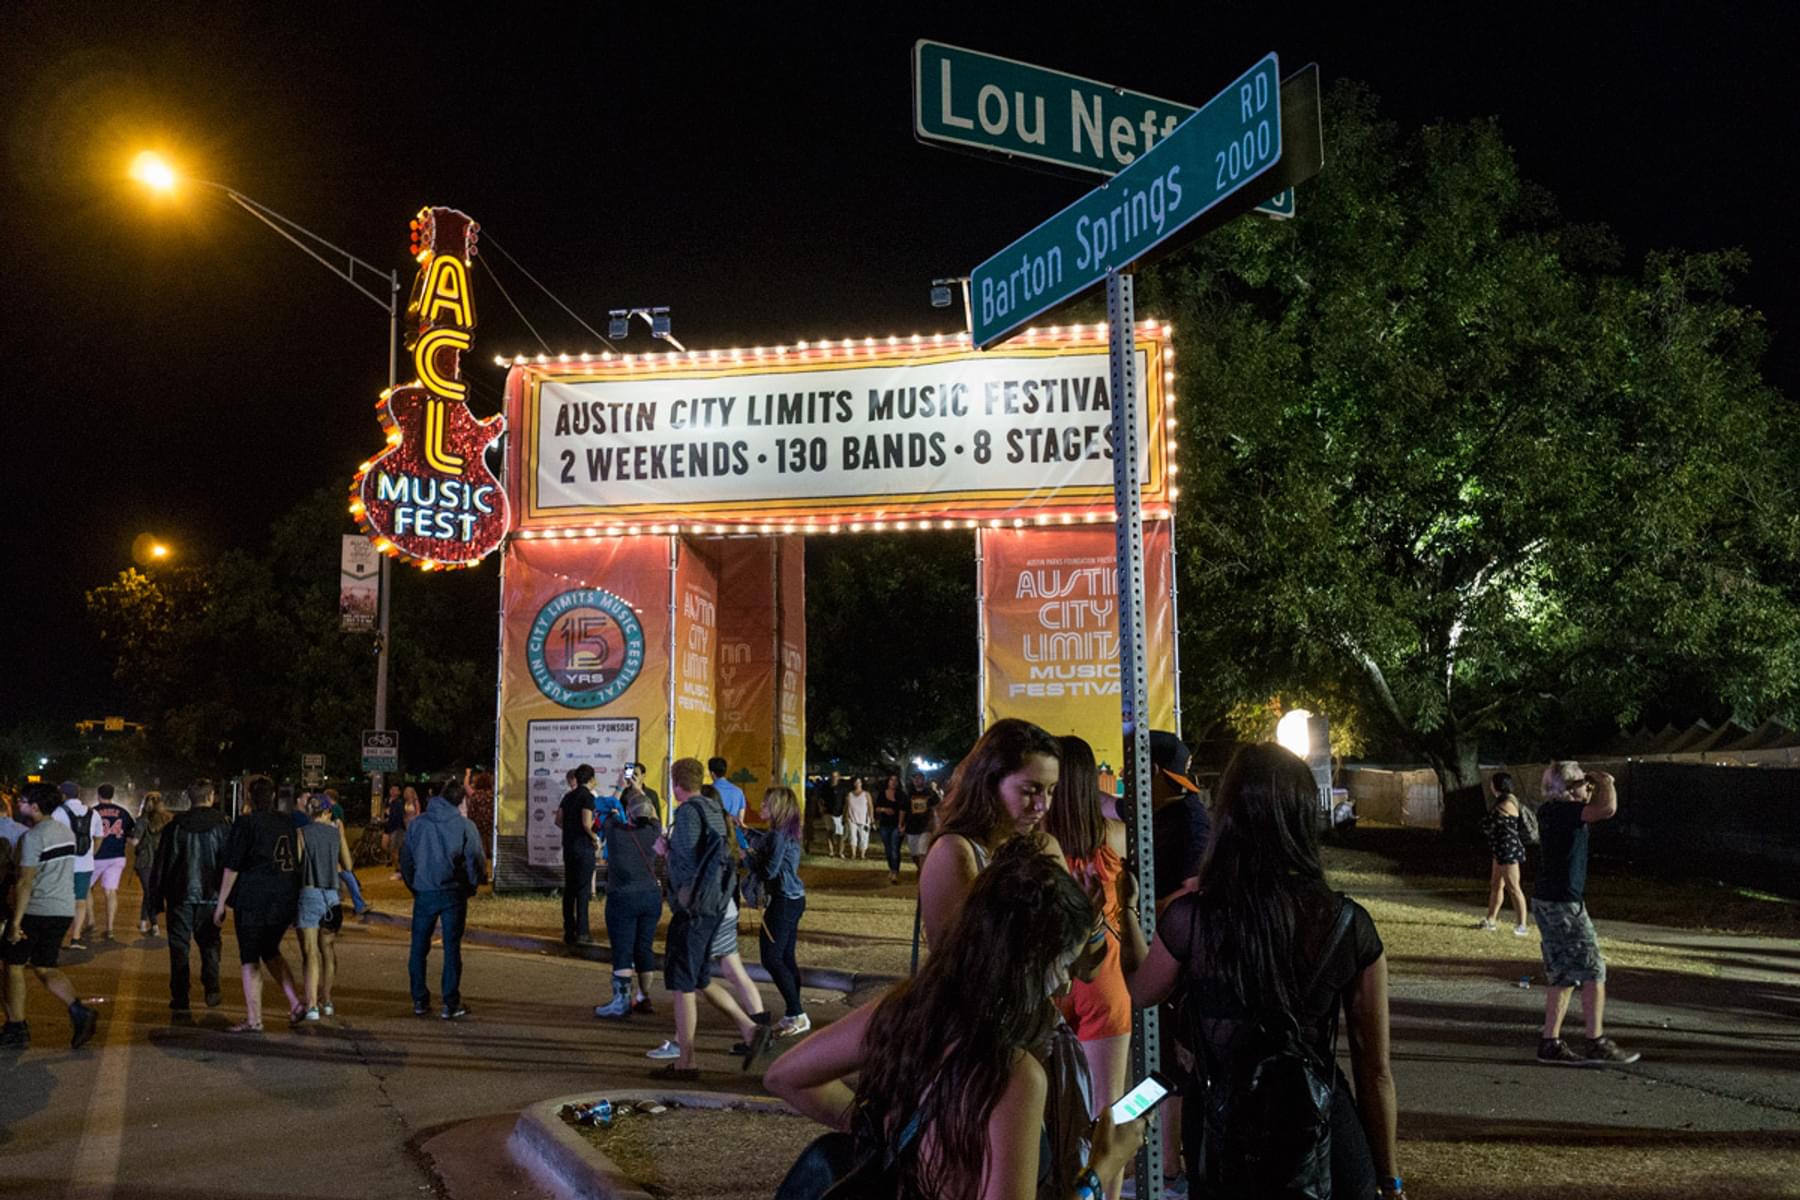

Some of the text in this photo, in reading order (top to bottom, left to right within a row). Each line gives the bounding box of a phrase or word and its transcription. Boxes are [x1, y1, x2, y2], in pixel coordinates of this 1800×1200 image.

[940, 58, 1046, 145] Lou
[1239, 71, 1269, 124] RD
[1215, 119, 1271, 191] 2000
[981, 164, 1182, 327] Barton Springs
[554, 376, 1111, 437] AUSTIN CITY LIMITS MUSIC FESTIVA
[560, 424, 1114, 484] 2 WEEKENDS 130 BANDS 8 STAGES
[376, 471, 495, 514] MUSIC
[394, 505, 477, 542] FEST
[1039, 599, 1113, 629] CITY
[530, 591, 641, 702] AUSTIN CITY LIMITS MUSIC FESTIVAL
[560, 616, 608, 669] 15
[565, 673, 604, 684] YRS
[683, 649, 709, 683] LIMIT
[1030, 664, 1121, 679] MUSIC
[1008, 682, 1122, 697] FESTIVA
[597, 722, 634, 732] SPONSORS
[272, 834, 294, 872] 4
